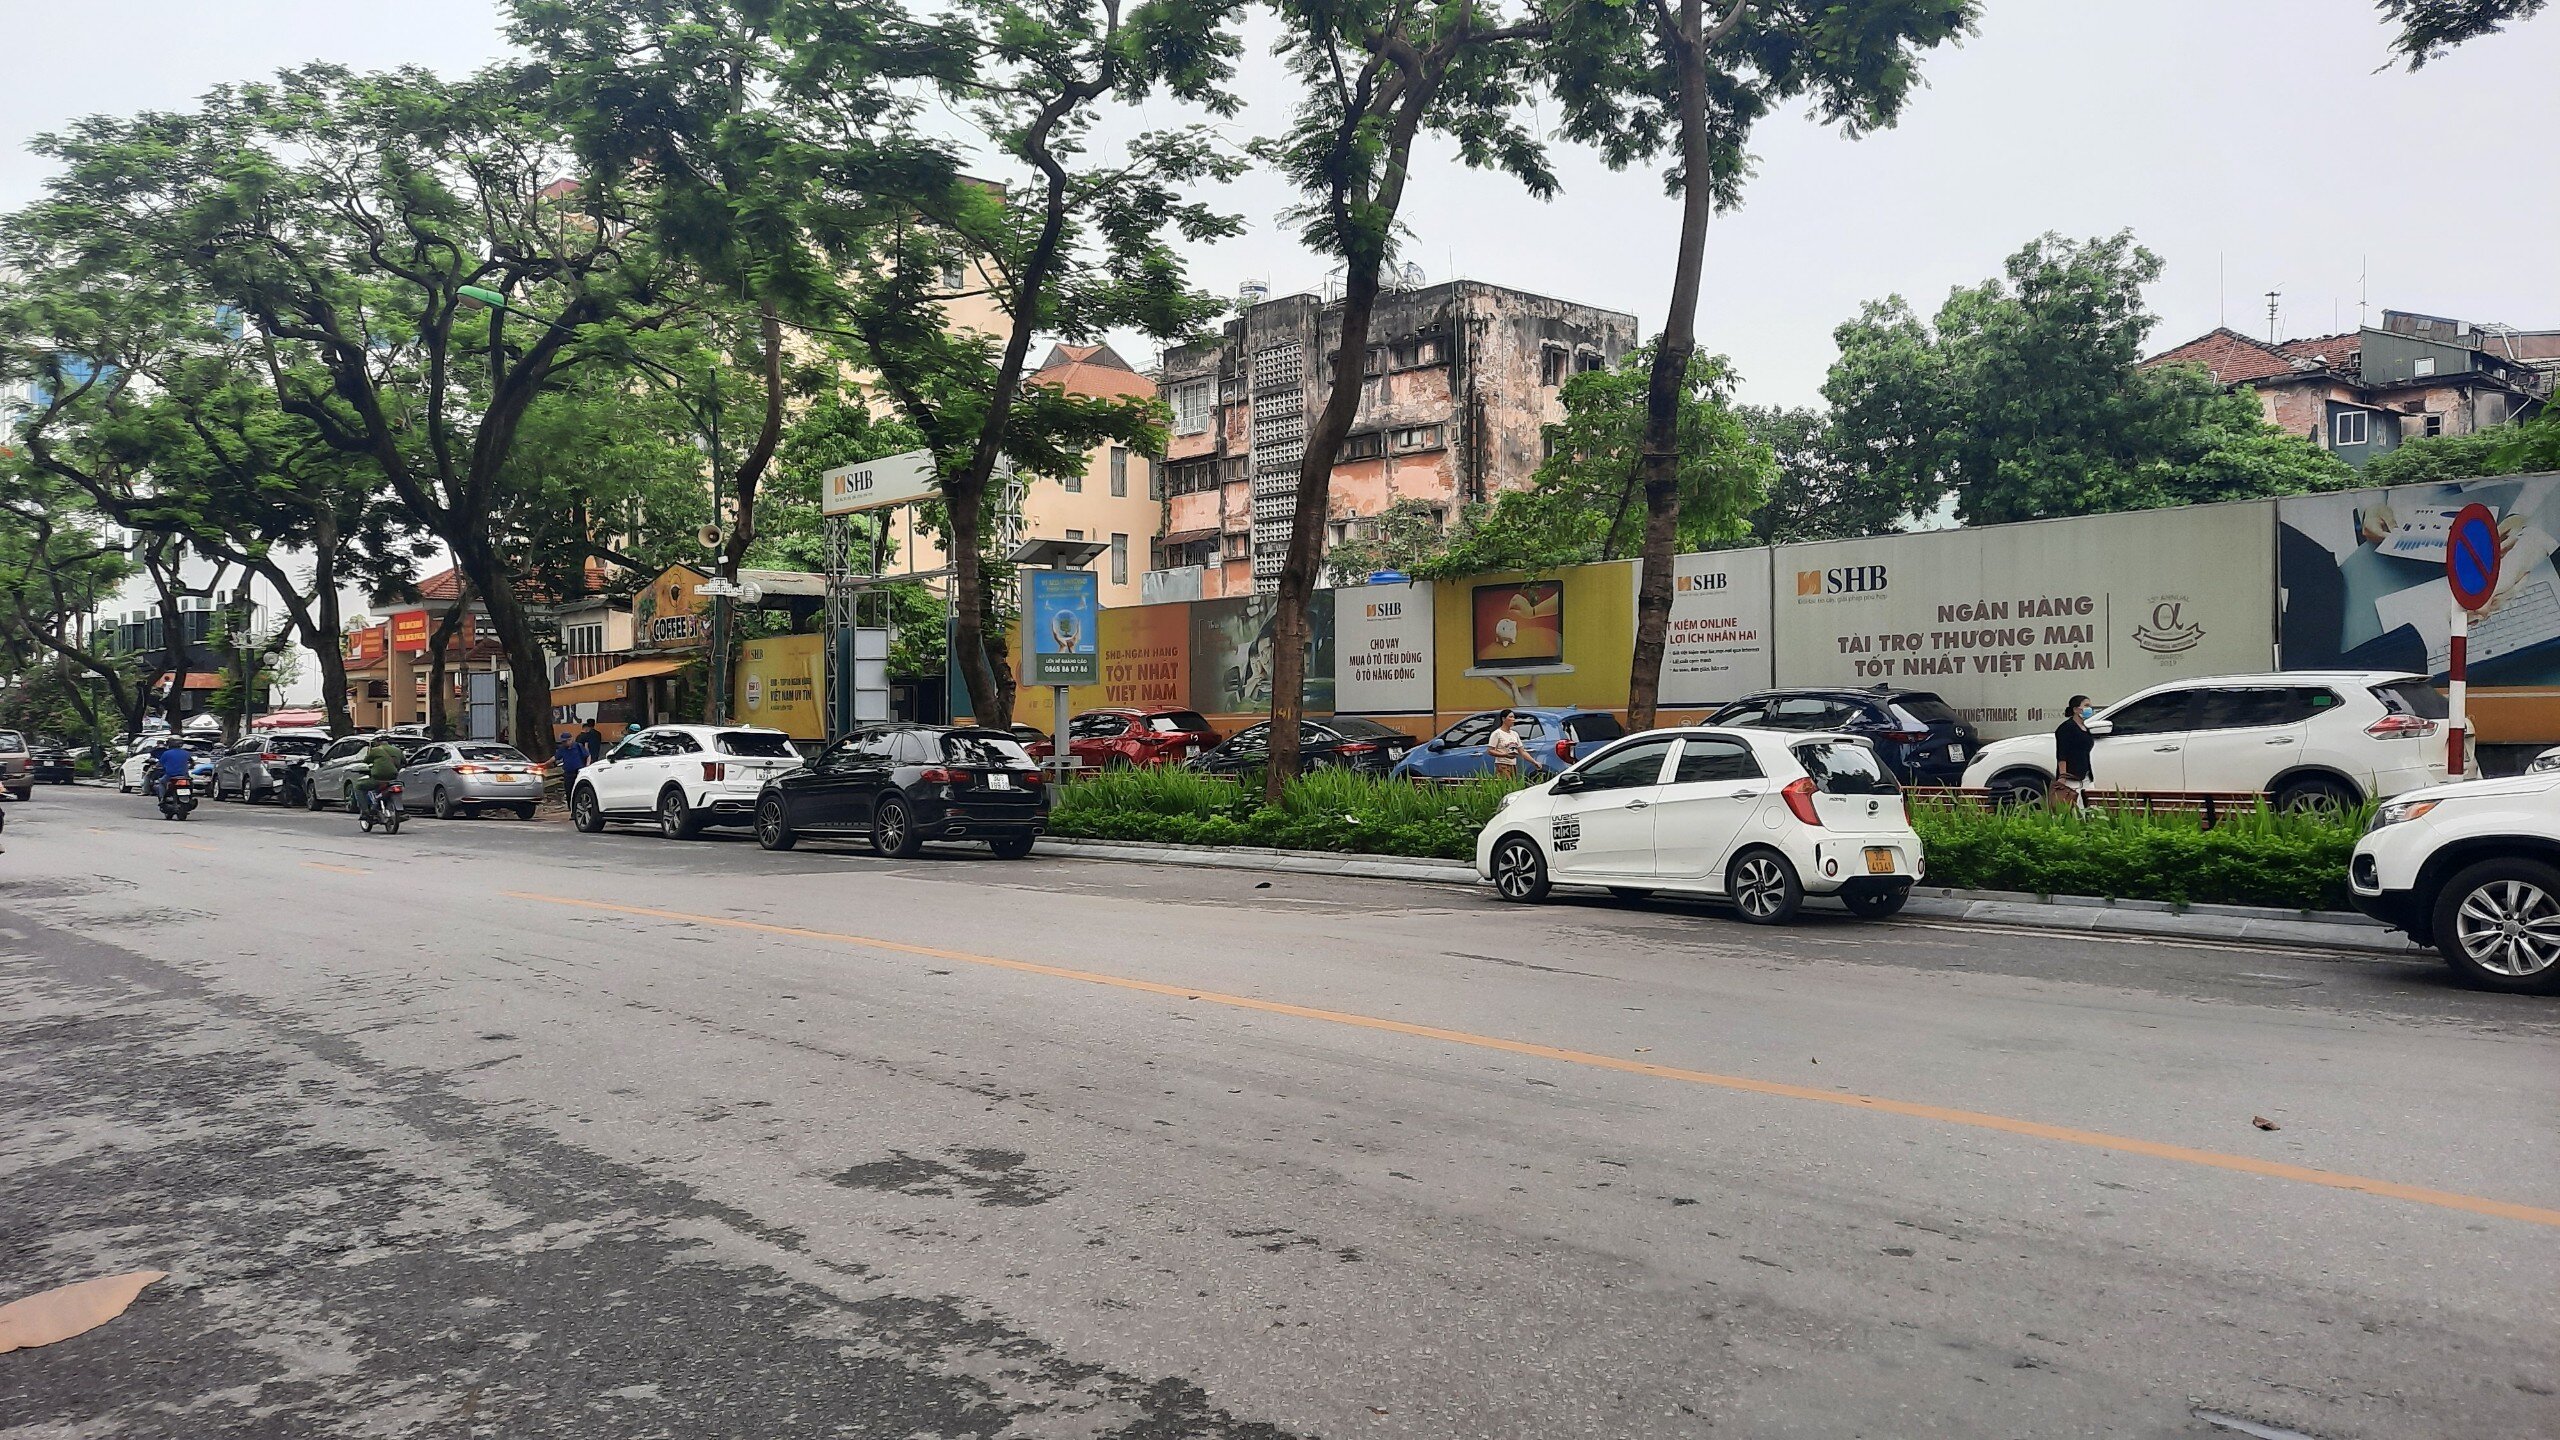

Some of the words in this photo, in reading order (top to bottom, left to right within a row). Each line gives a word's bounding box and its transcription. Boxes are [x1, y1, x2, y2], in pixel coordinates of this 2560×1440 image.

[847, 470, 873, 493] SHB
[1694, 573, 1728, 590] SHB
[1827, 565, 1888, 594] SHB
[1378, 602, 1402, 617] SHB
[1938, 600, 2009, 623] NGÂN
[2018, 595, 2094, 618] HÀNG
[653, 616, 687, 641] COFFEE
[1700, 618, 1738, 629] ONLINE
[1370, 638, 1385, 650] CHO
[1386, 638, 1399, 649] VAY
[1670, 634, 1686, 646] LỢI
[1739, 630, 1757, 640] HAI
[1838, 633, 1871, 653] TÀI
[1879, 632, 1924, 655] TRỢ
[1931, 628, 2035, 650] THƯƠNG
[2043, 624, 2094, 648] MẠI
[750, 648, 764, 660] SHB
[1349, 655, 1364, 666] MUA
[1367, 653, 1372, 665] Ô
[1373, 652, 1382, 665] TÔ
[1383, 652, 1399, 664] TIÊU
[1401, 651, 1422, 663] DÙNG
[1106, 661, 1132, 682] TỐT
[1138, 660, 1178, 680] NHẤT
[1855, 654, 1896, 677] TỐT
[1903, 652, 1966, 676] NHẤT
[1972, 652, 2025, 677] VIỆT
[2034, 651, 2095, 671] NAM
[1356, 669, 1361, 681] Ô
[1362, 669, 1371, 681] TÔ
[1394, 668, 1415, 682] ĐỘNG
[1106, 683, 1136, 705] VIỆT
[1142, 683, 1177, 700] NAM
[1986, 708, 2018, 722] FINANCE
[1553, 825, 1580, 839] HKS
[1554, 839, 1580, 852] NOS
